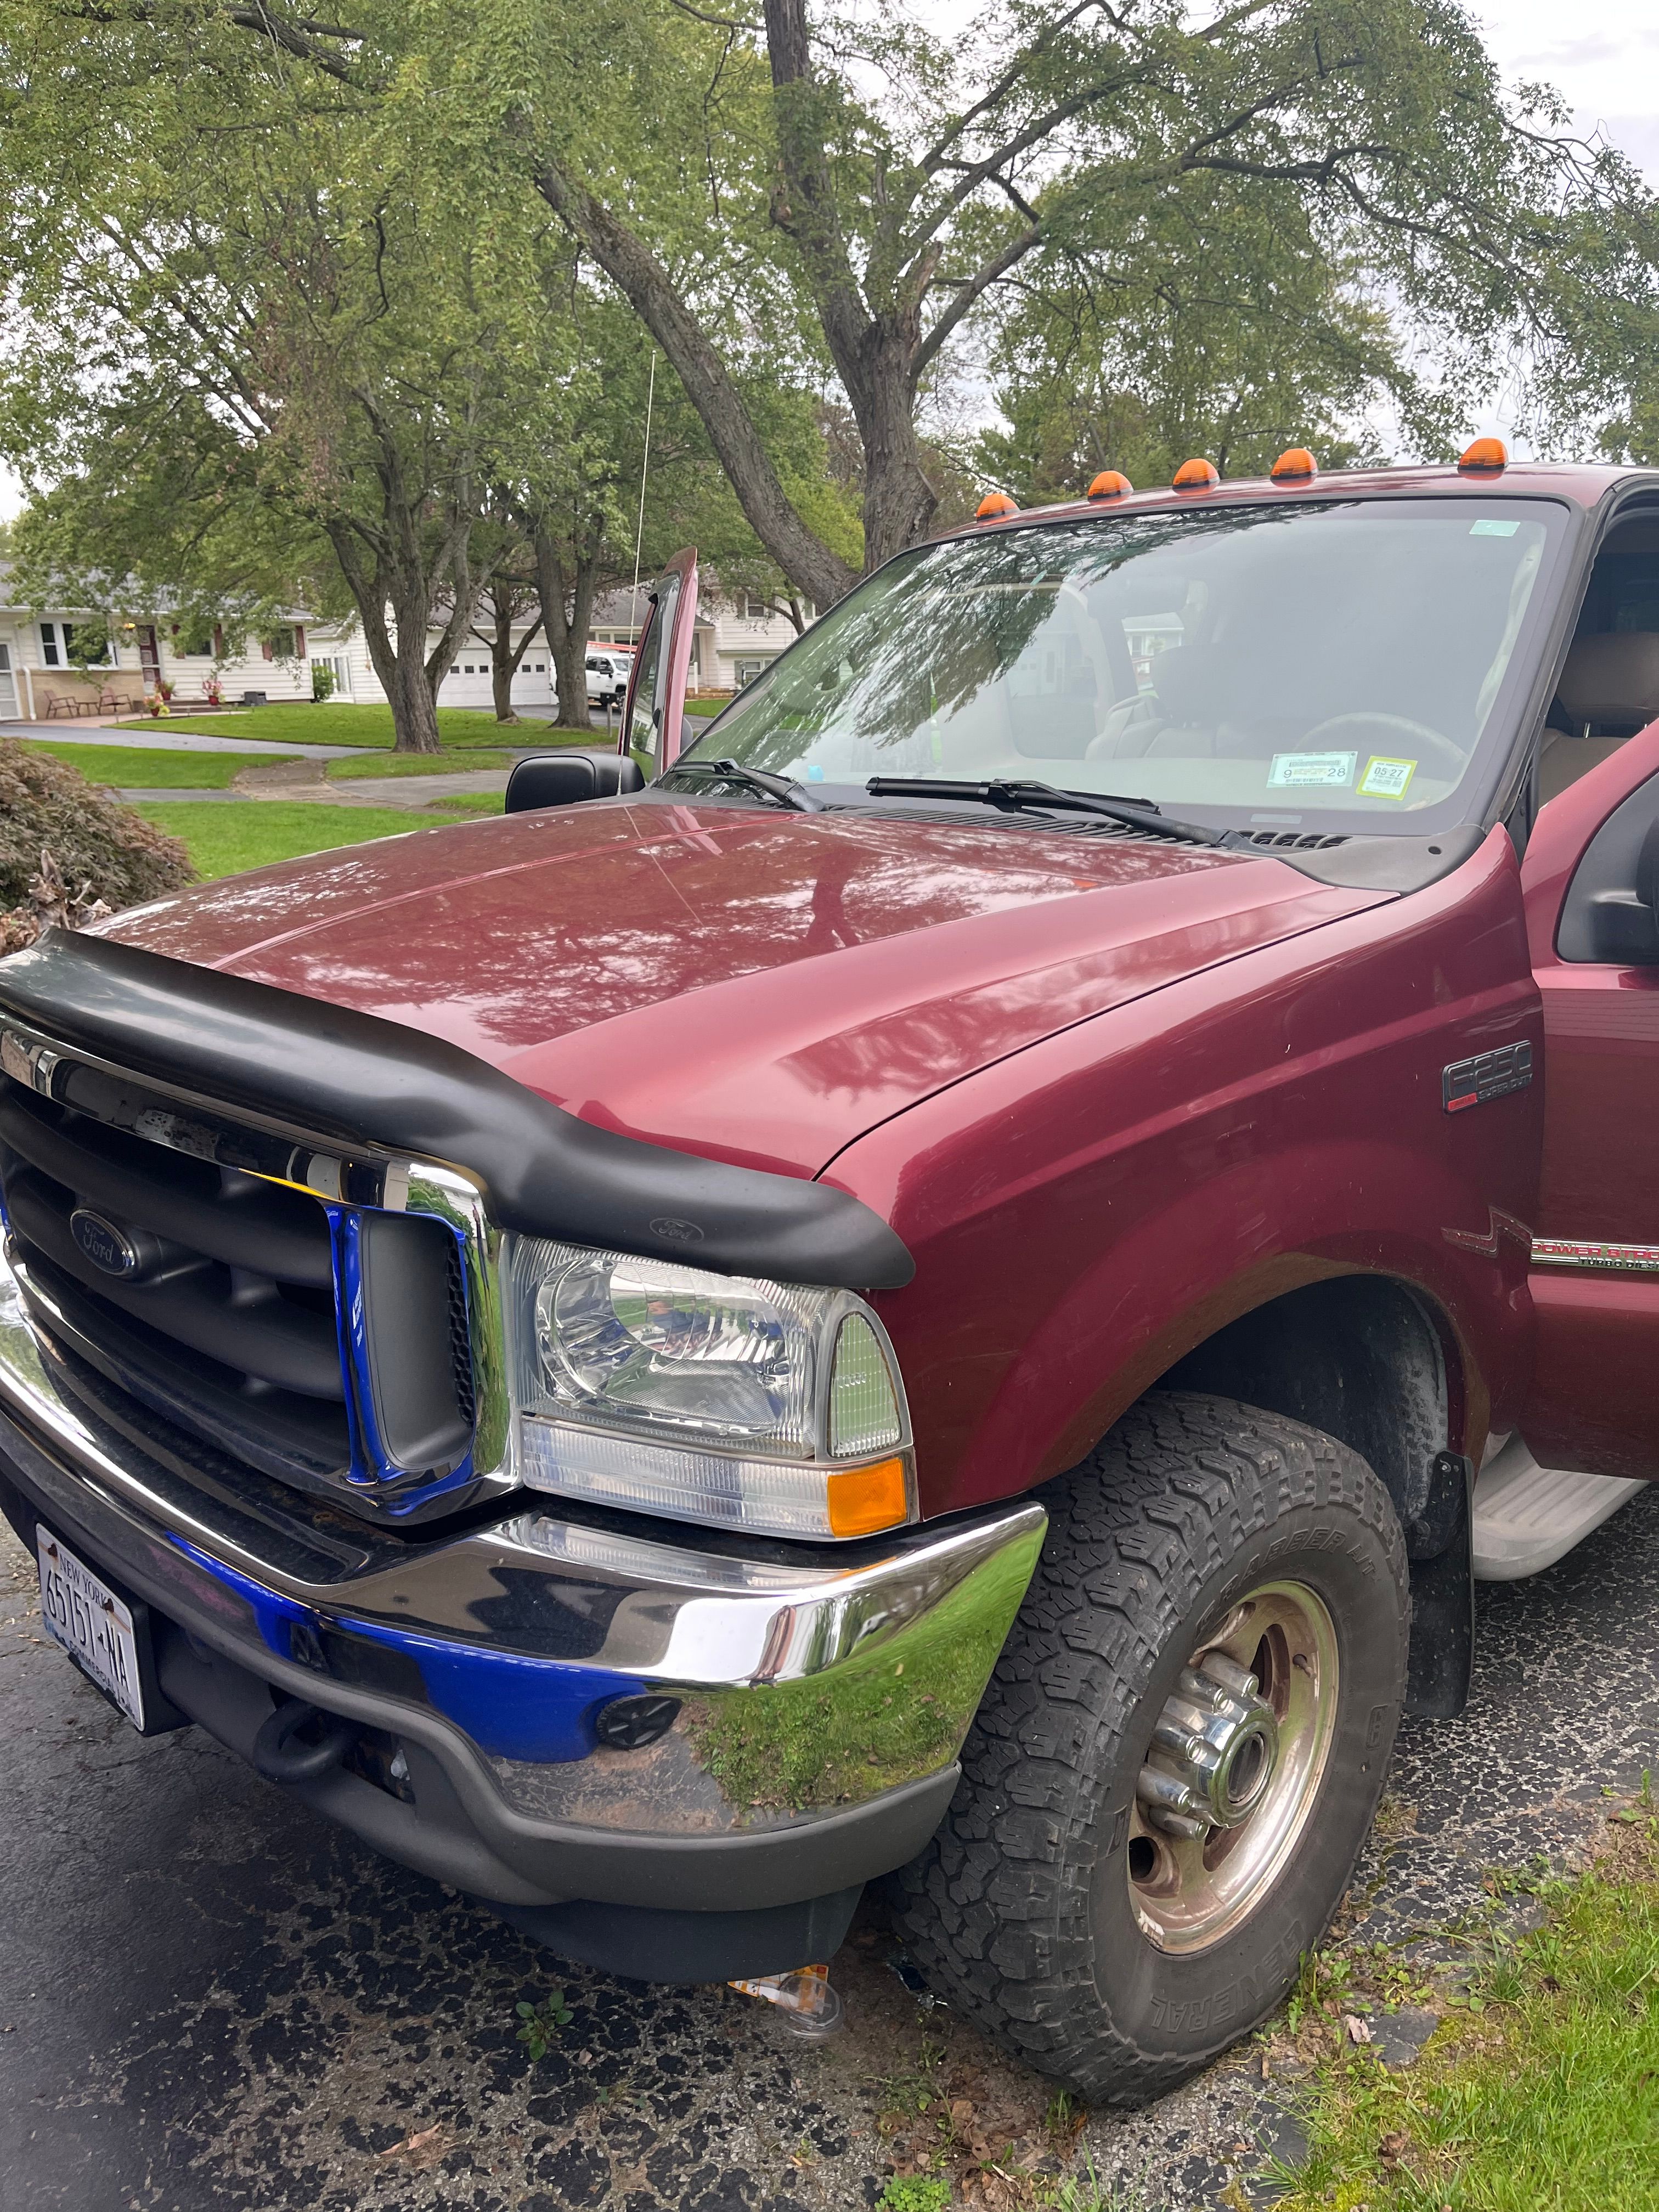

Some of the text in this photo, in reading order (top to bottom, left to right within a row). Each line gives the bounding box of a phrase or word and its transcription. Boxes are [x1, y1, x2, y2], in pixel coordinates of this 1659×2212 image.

[1283, 769, 1292, 778] 9
[1327, 768, 1346, 777] 28
[1374, 767, 1387, 775] 05
[1389, 769, 1404, 777] 27
[658, 1220, 693, 1240] Ford
[83, 1221, 114, 1264] Ford
[1531, 1242, 1601, 1256] POWER
[1579, 1256, 1622, 1267] TURBO
[59, 1551, 107, 1611] NEW YORK
[46, 1568, 131, 1694] 65151-NA
[1150, 1918, 1307, 2034] GENERAL
